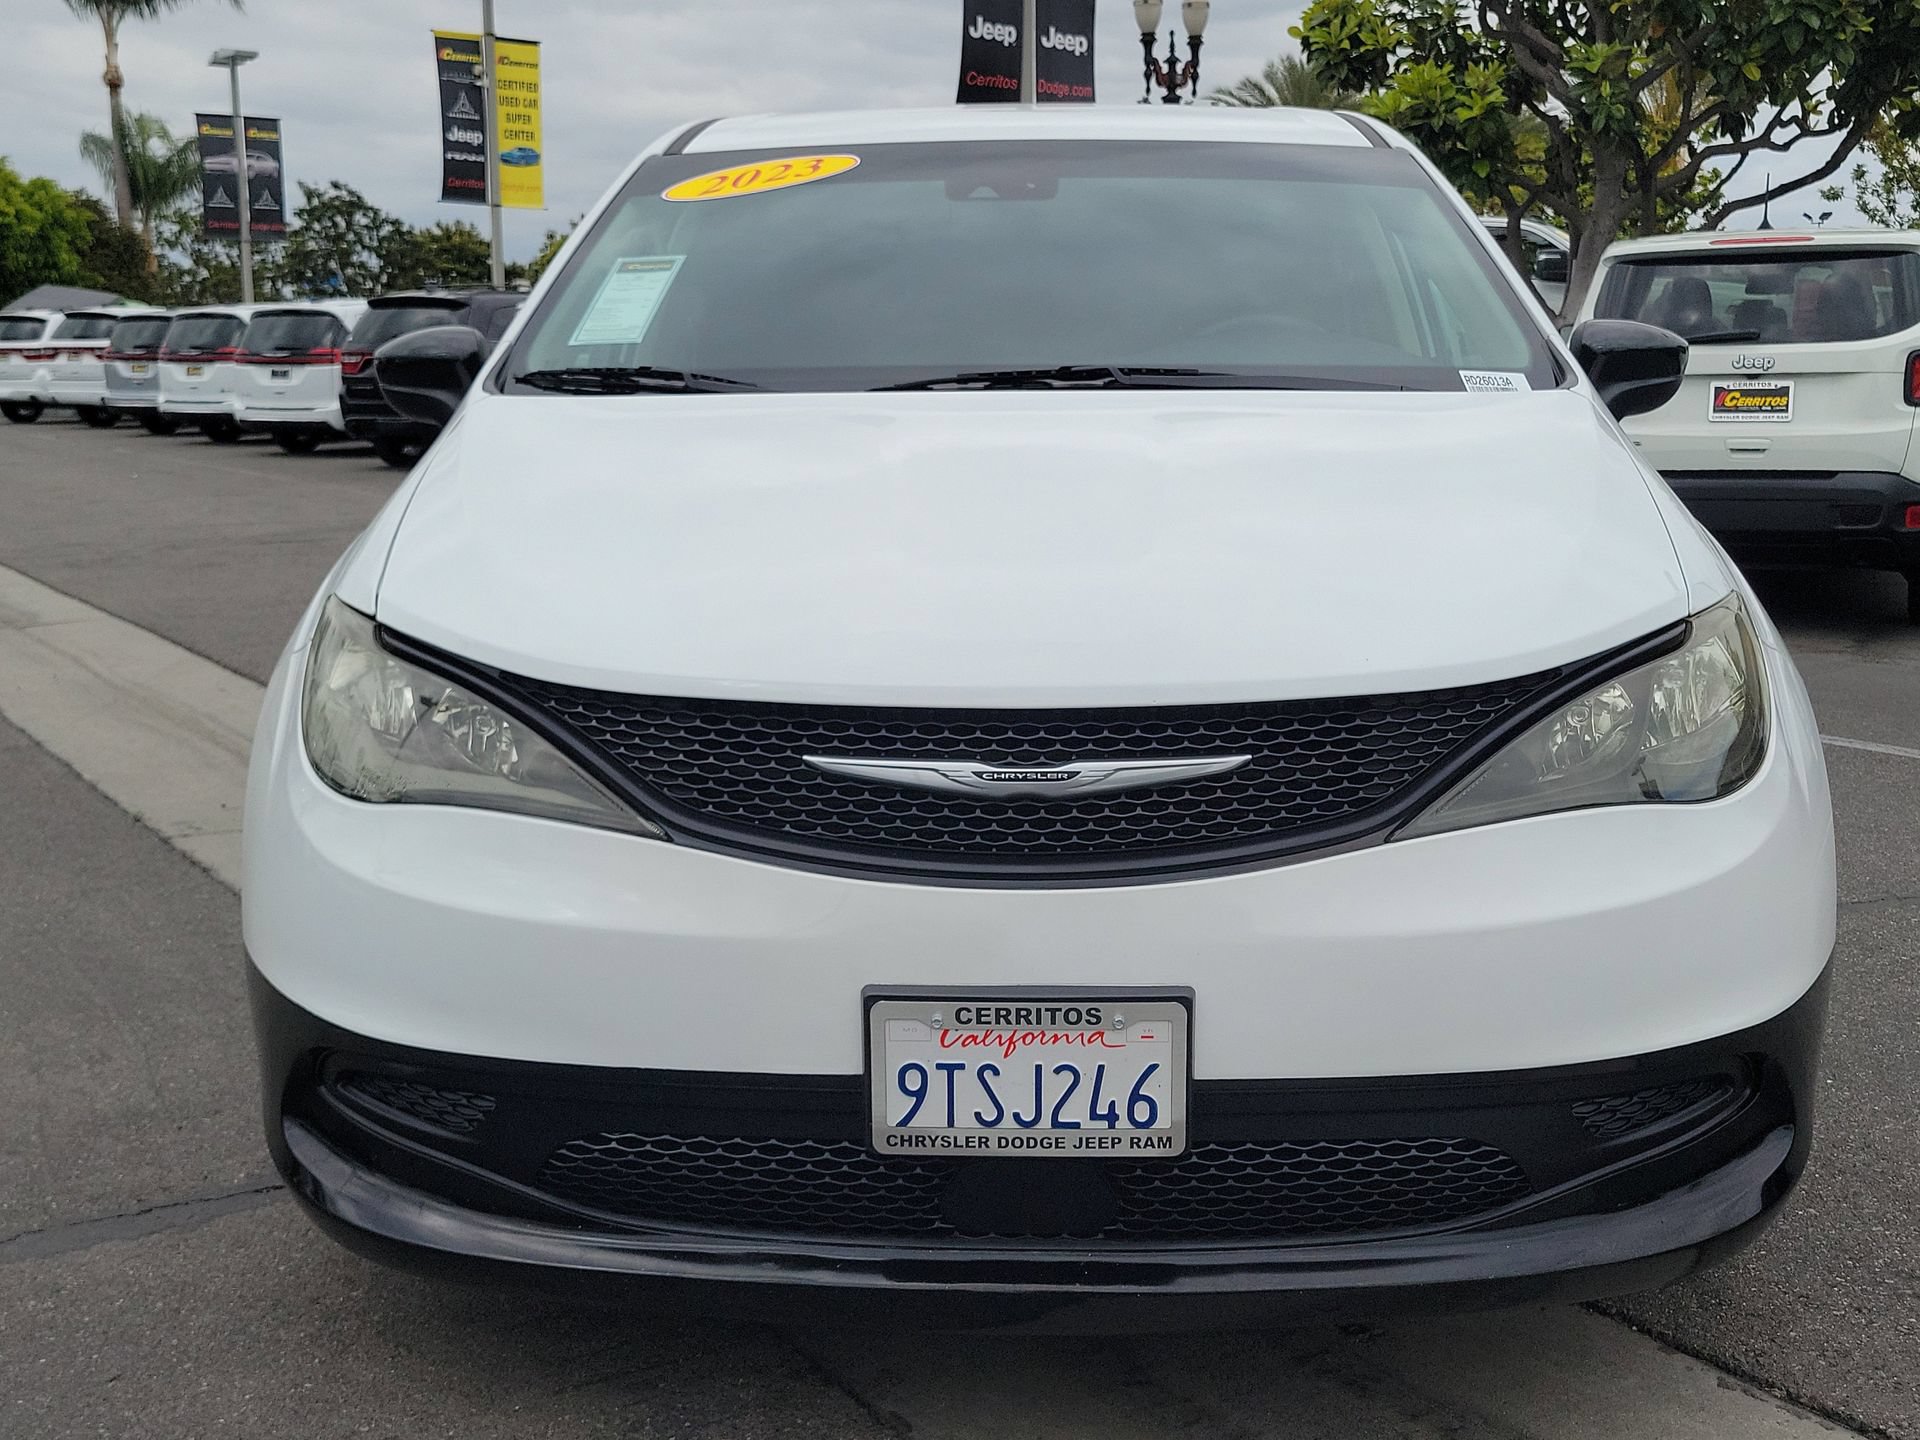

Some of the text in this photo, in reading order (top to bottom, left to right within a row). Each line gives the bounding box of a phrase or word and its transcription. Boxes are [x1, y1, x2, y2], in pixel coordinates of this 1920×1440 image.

[968, 14, 1018, 47] Jeep
[1040, 26, 1089, 57] Jeep
[497, 79, 539, 94] CERTIFIED
[966, 71, 1018, 90] Cerritos
[1037, 79, 1093, 97] Dodge.com
[498, 94, 539, 111] USED CAR
[506, 112, 532, 126] SUPER
[445, 125, 484, 147] Jeep
[504, 128, 536, 142] CENTER
[700, 159, 825, 196] 2023
[1732, 354, 1775, 371] Jeep
[981, 772, 1069, 780] CHRYSLER
[954, 1006, 1103, 1027] CERRITOS
[939, 1028, 1127, 1060] California
[895, 1061, 1162, 1129] 9TSJ246
[885, 1134, 1174, 1150] CHRYSLER DODGE JEEP RAM
